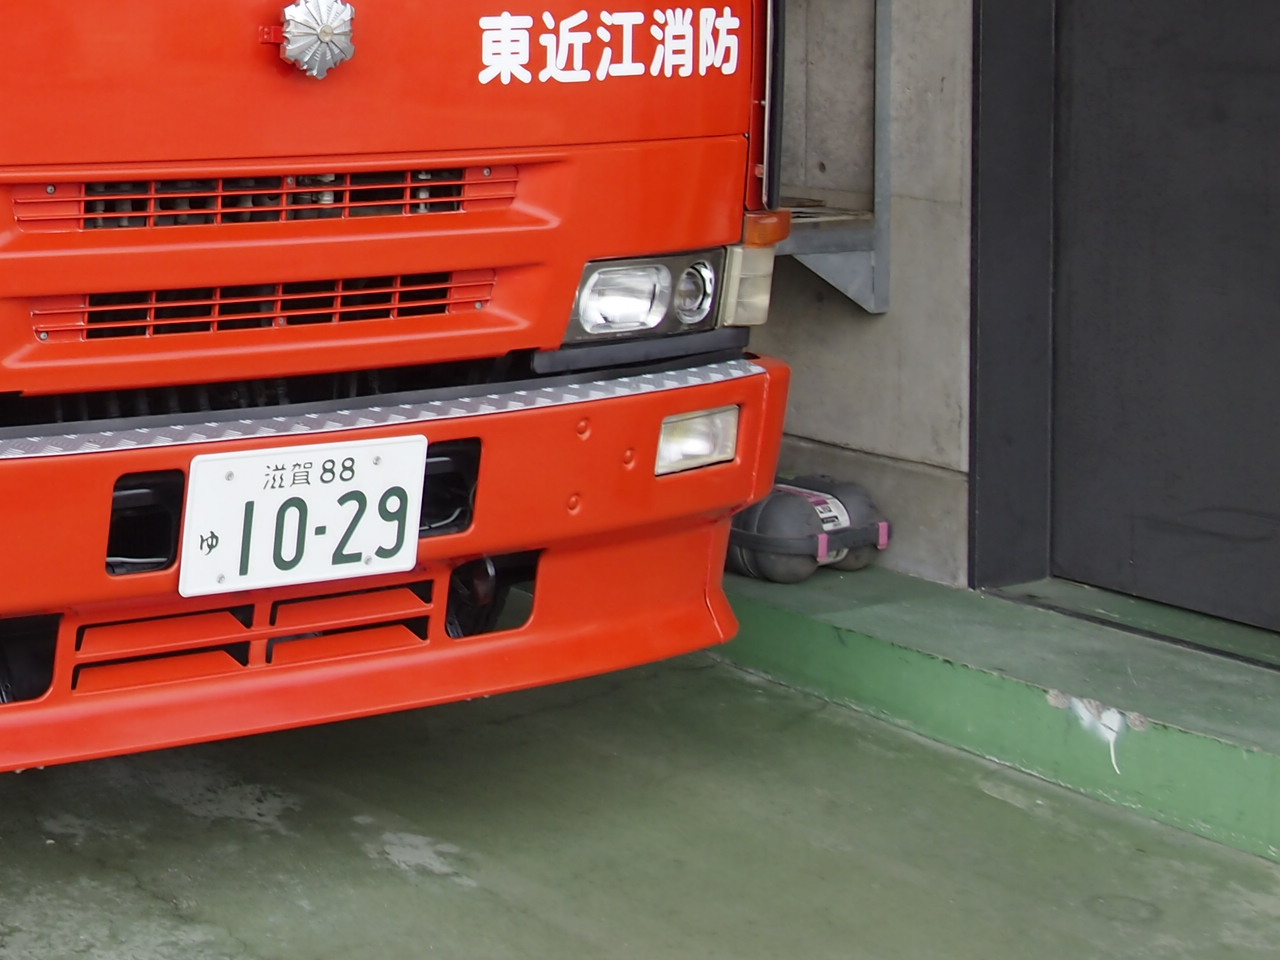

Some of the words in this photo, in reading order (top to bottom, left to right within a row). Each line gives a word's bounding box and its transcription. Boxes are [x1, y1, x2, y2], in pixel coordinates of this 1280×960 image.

[478, 6, 740, 85] 東近江消防
[199, 530, 219, 556] ゆ
[239, 486, 409, 576] 10-29
